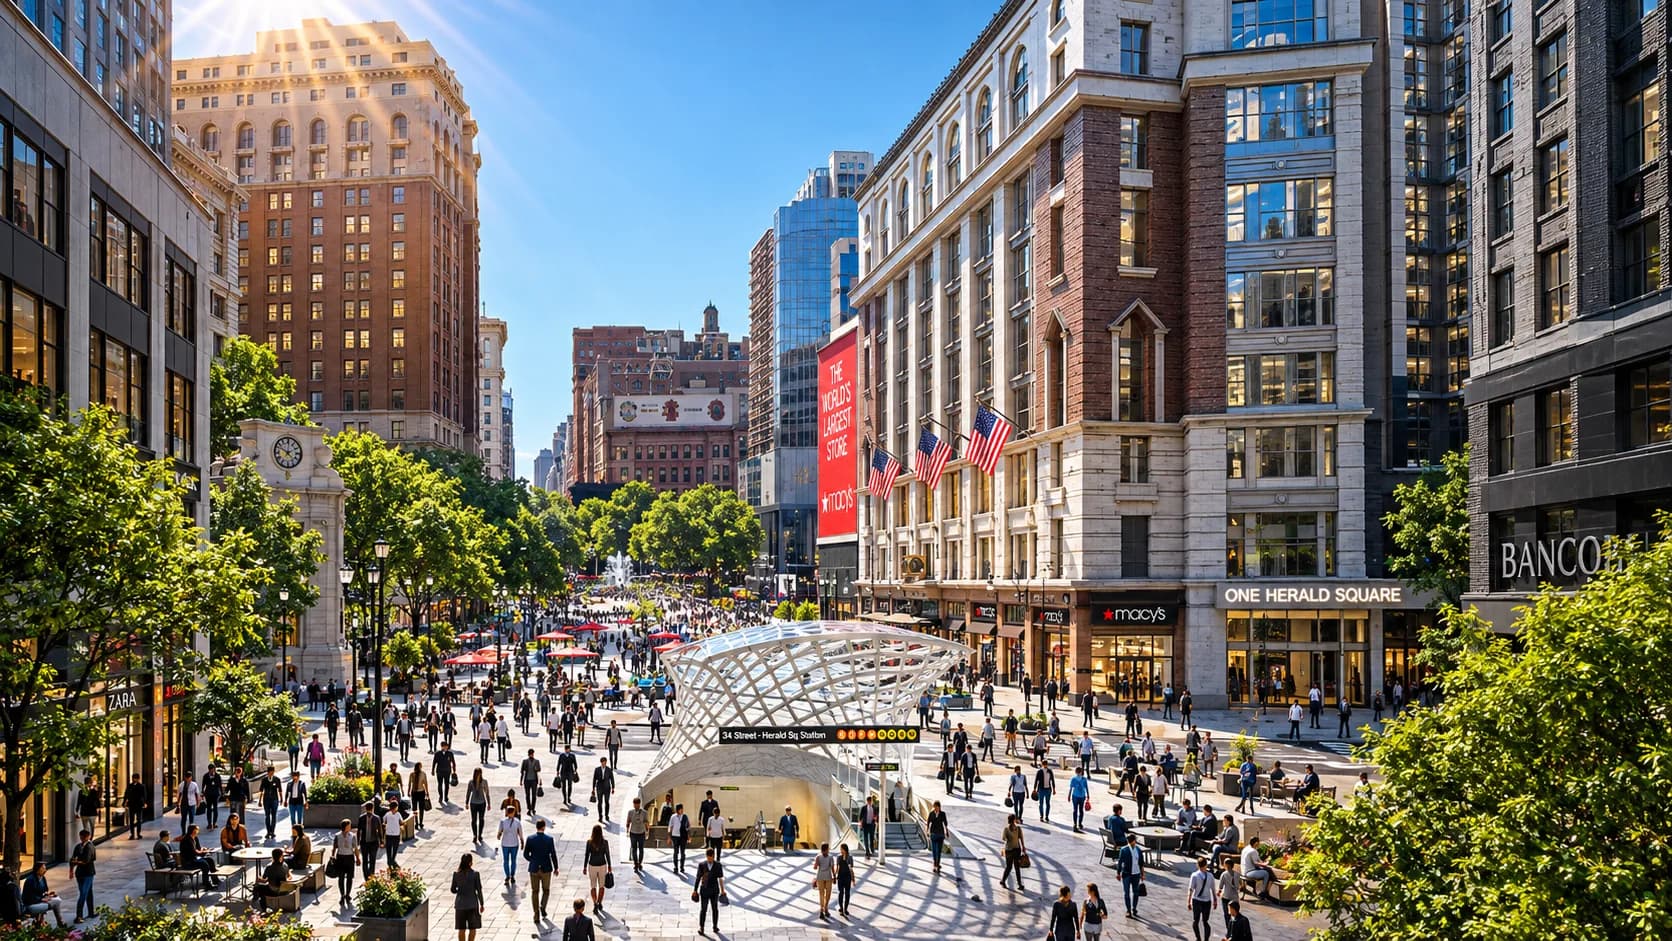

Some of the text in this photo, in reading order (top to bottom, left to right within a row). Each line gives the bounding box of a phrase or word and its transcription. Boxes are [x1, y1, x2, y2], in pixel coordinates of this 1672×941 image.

[830, 360, 843, 385] THE
[822, 381, 852, 413] WORLD'S
[823, 406, 852, 437] LARGEST
[826, 434, 848, 461] STORE
[828, 483, 854, 512] macy's
[1224, 587, 1402, 603] ONE HERALD SQUARE
[1115, 606, 1166, 623] macy's
[109, 691, 137, 711] ZARA
[722, 731, 732, 739] 34
[734, 730, 757, 739] Street
[762, 730, 787, 739] Herald
